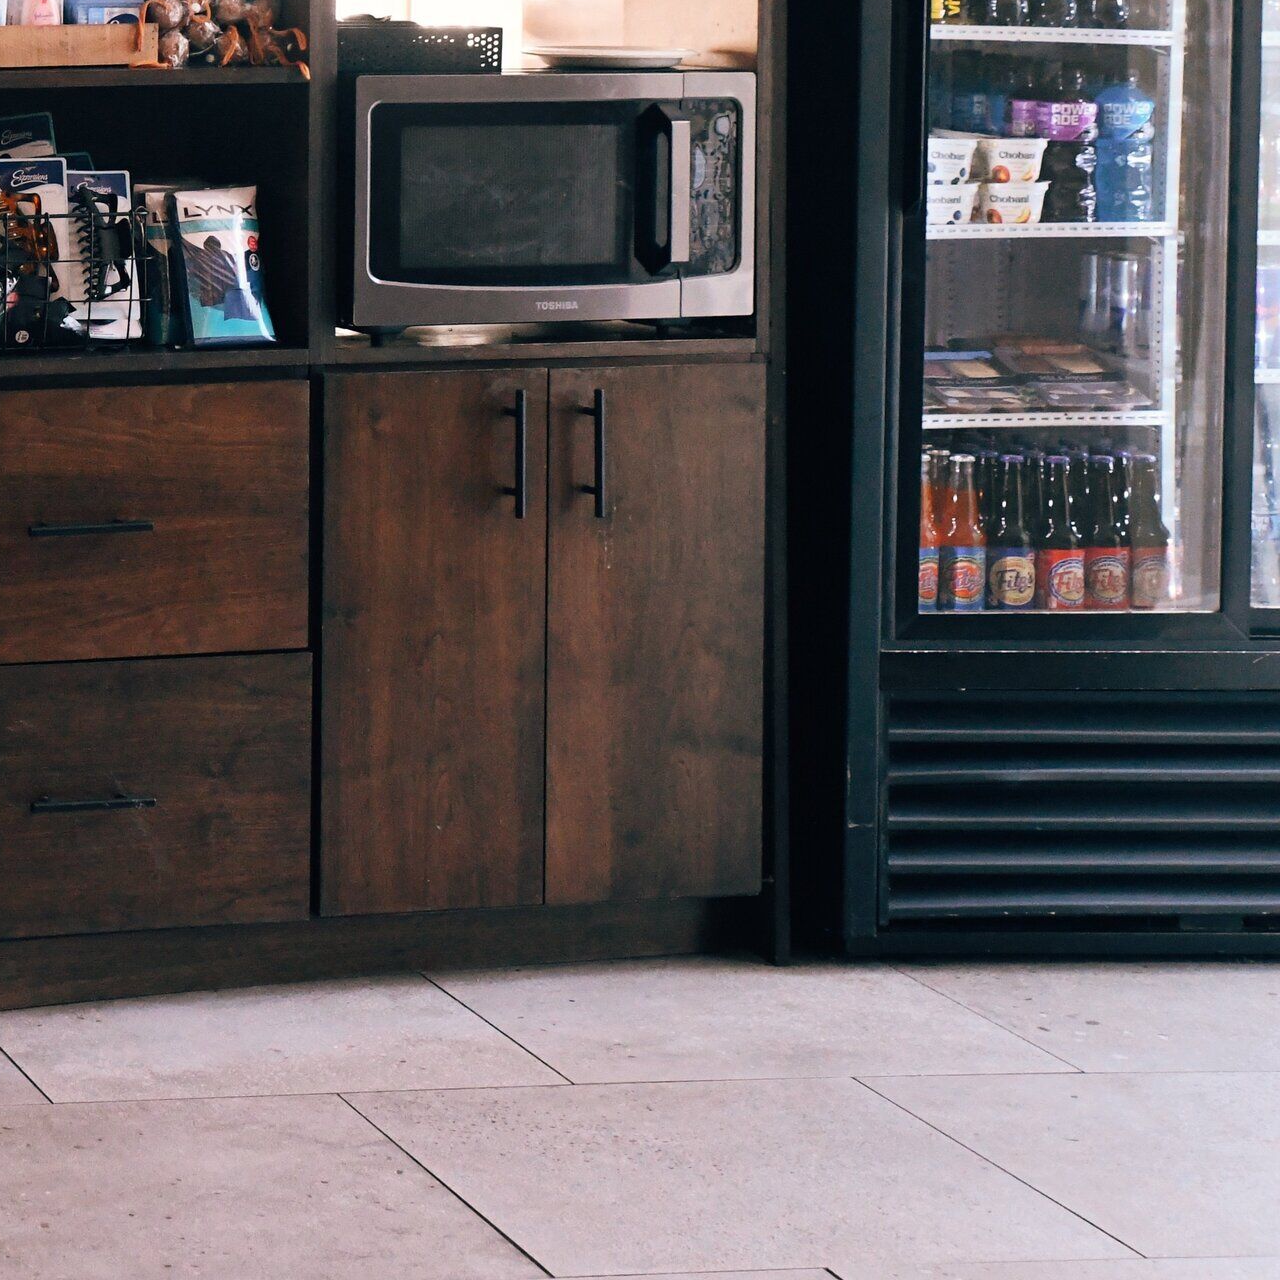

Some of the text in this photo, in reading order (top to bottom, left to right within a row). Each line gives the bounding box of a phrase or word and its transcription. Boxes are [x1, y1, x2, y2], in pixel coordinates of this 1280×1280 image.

[1051, 103, 1098, 115] POWER
[1104, 102, 1152, 115] POWER
[1051, 115, 1079, 125] ADE
[1104, 115, 1131, 125] ADE
[999, 150, 1035, 159] Chobani
[990, 195, 1030, 204] Chobani
[183, 203, 252, 218] LYNX
[535, 301, 578, 310] TOSHIBA
